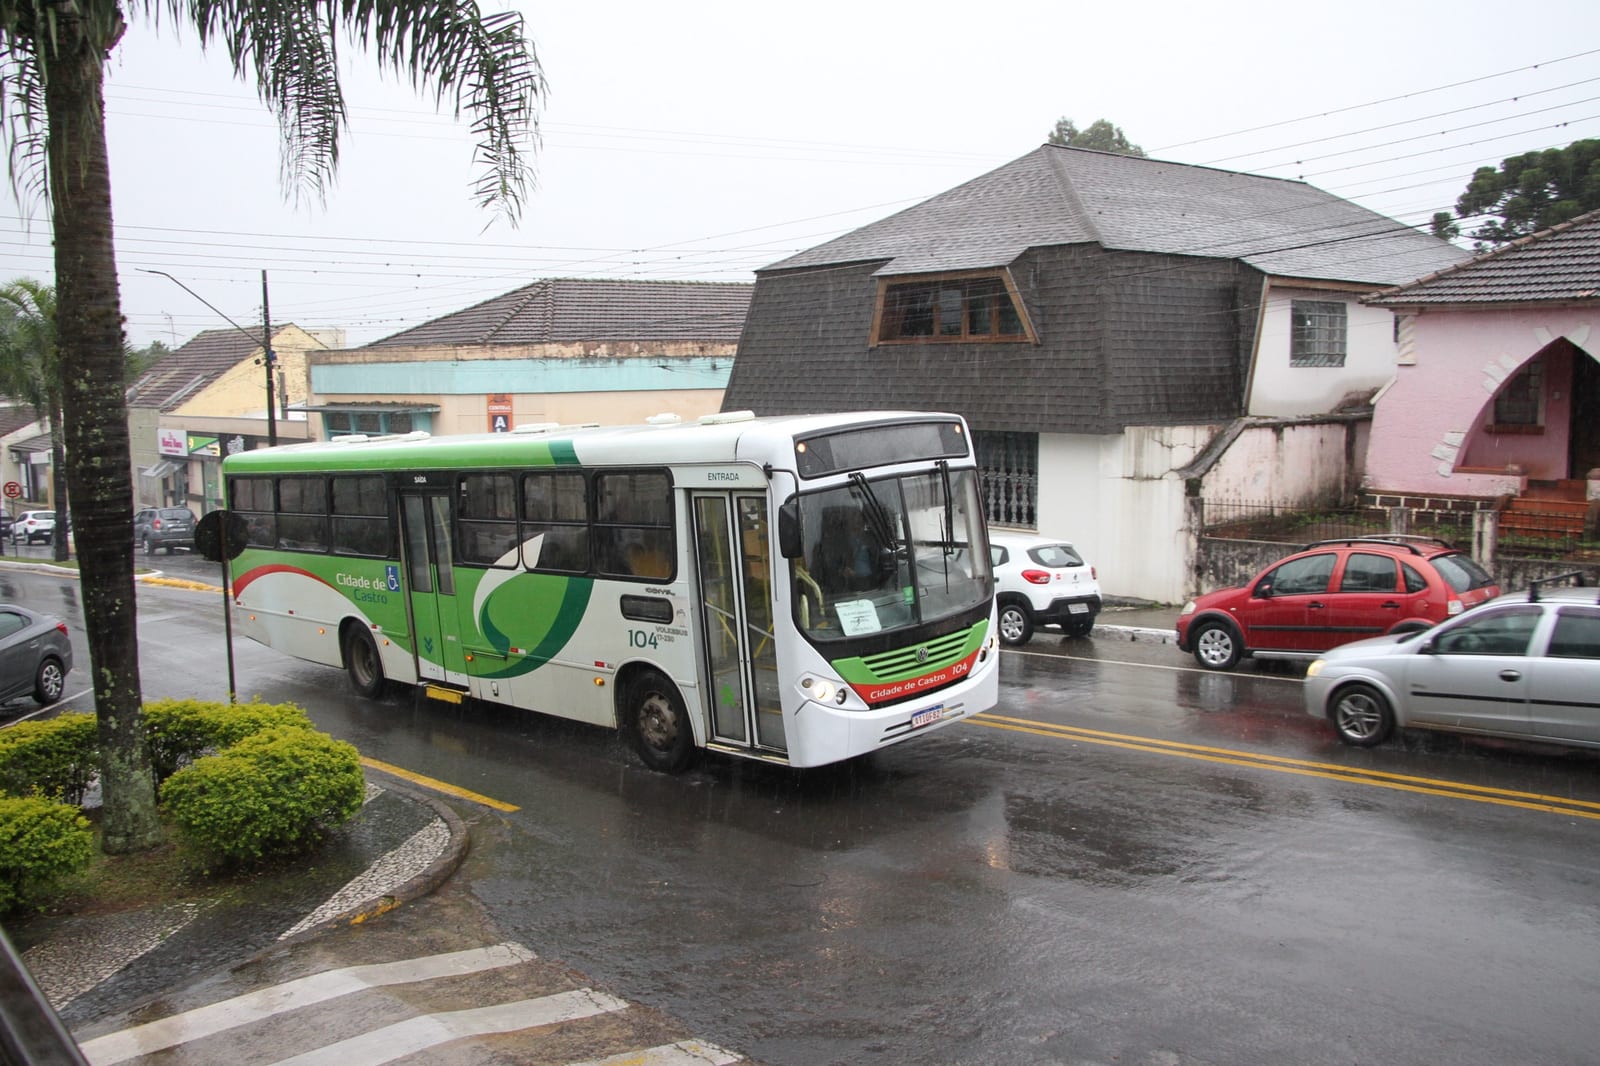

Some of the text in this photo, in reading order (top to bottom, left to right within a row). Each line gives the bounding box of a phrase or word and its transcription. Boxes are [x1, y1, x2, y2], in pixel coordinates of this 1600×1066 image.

[707, 473, 740, 481] ENTRADA
[336, 573, 386, 591] Cidade de
[353, 589, 388, 604] Castro
[628, 630, 658, 649] 104
[870, 663, 968, 699] Cidade de Castro 104
